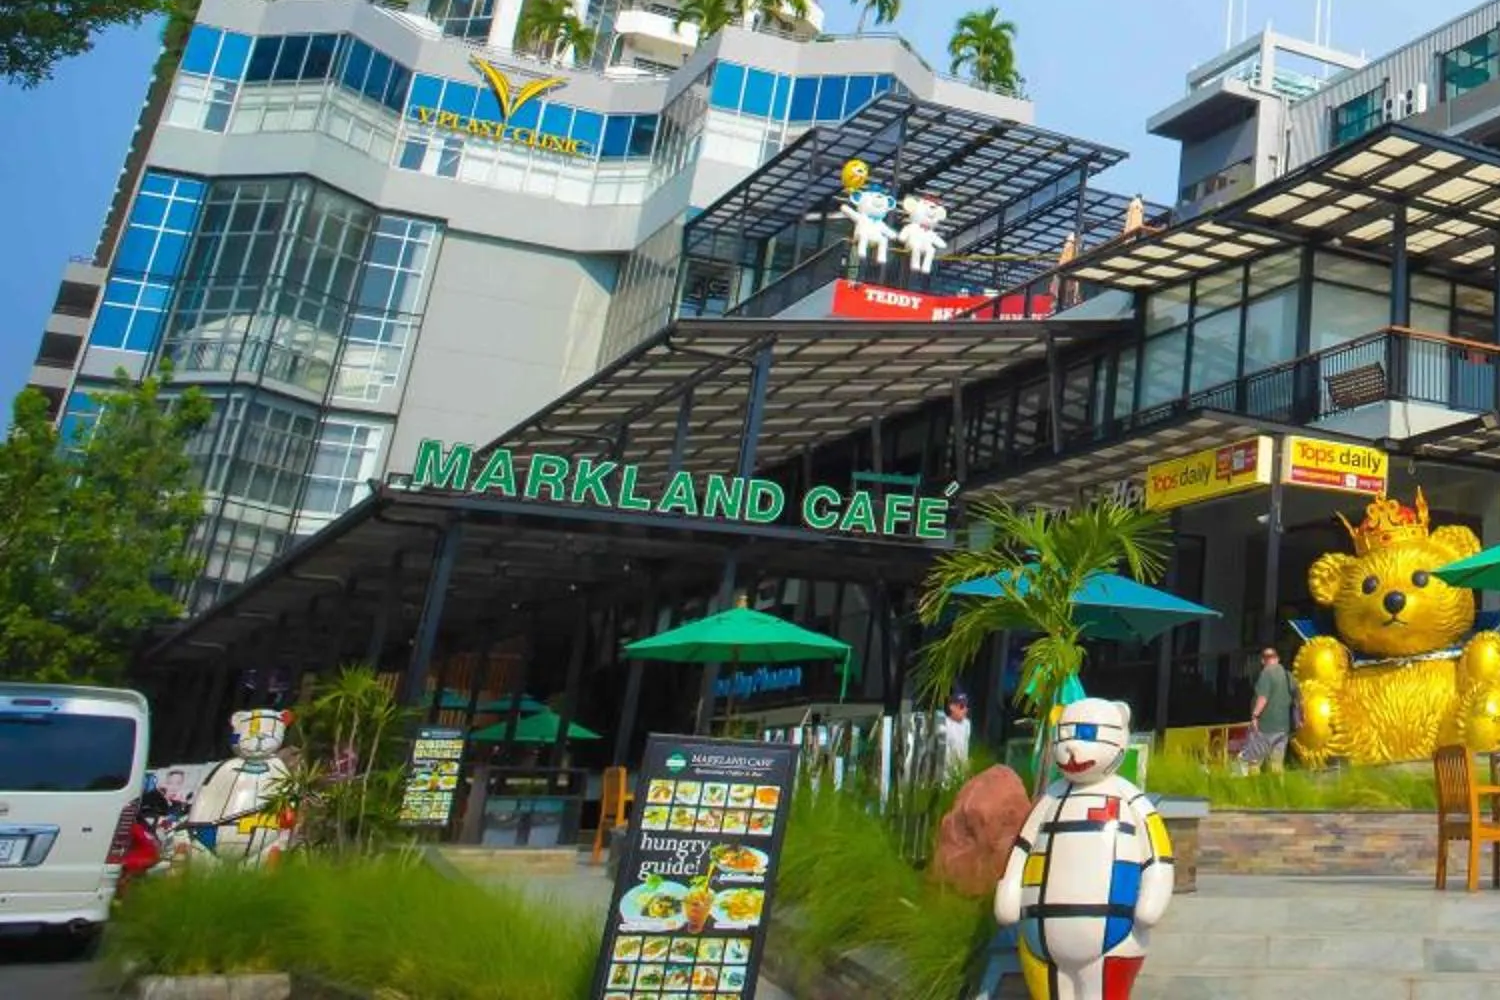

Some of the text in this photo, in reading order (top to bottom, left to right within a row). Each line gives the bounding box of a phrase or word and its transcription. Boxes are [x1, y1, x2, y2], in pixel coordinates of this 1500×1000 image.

[418, 105, 587, 158] V PLAST CLINIC
[865, 288, 922, 310] TEDDY
[1296, 442, 1381, 474] Tops daily
[1180, 461, 1212, 486] daily
[413, 438, 960, 540] MARKLAND CAFÉ
[640, 832, 712, 859] hungry
[638, 857, 701, 881] guide!
